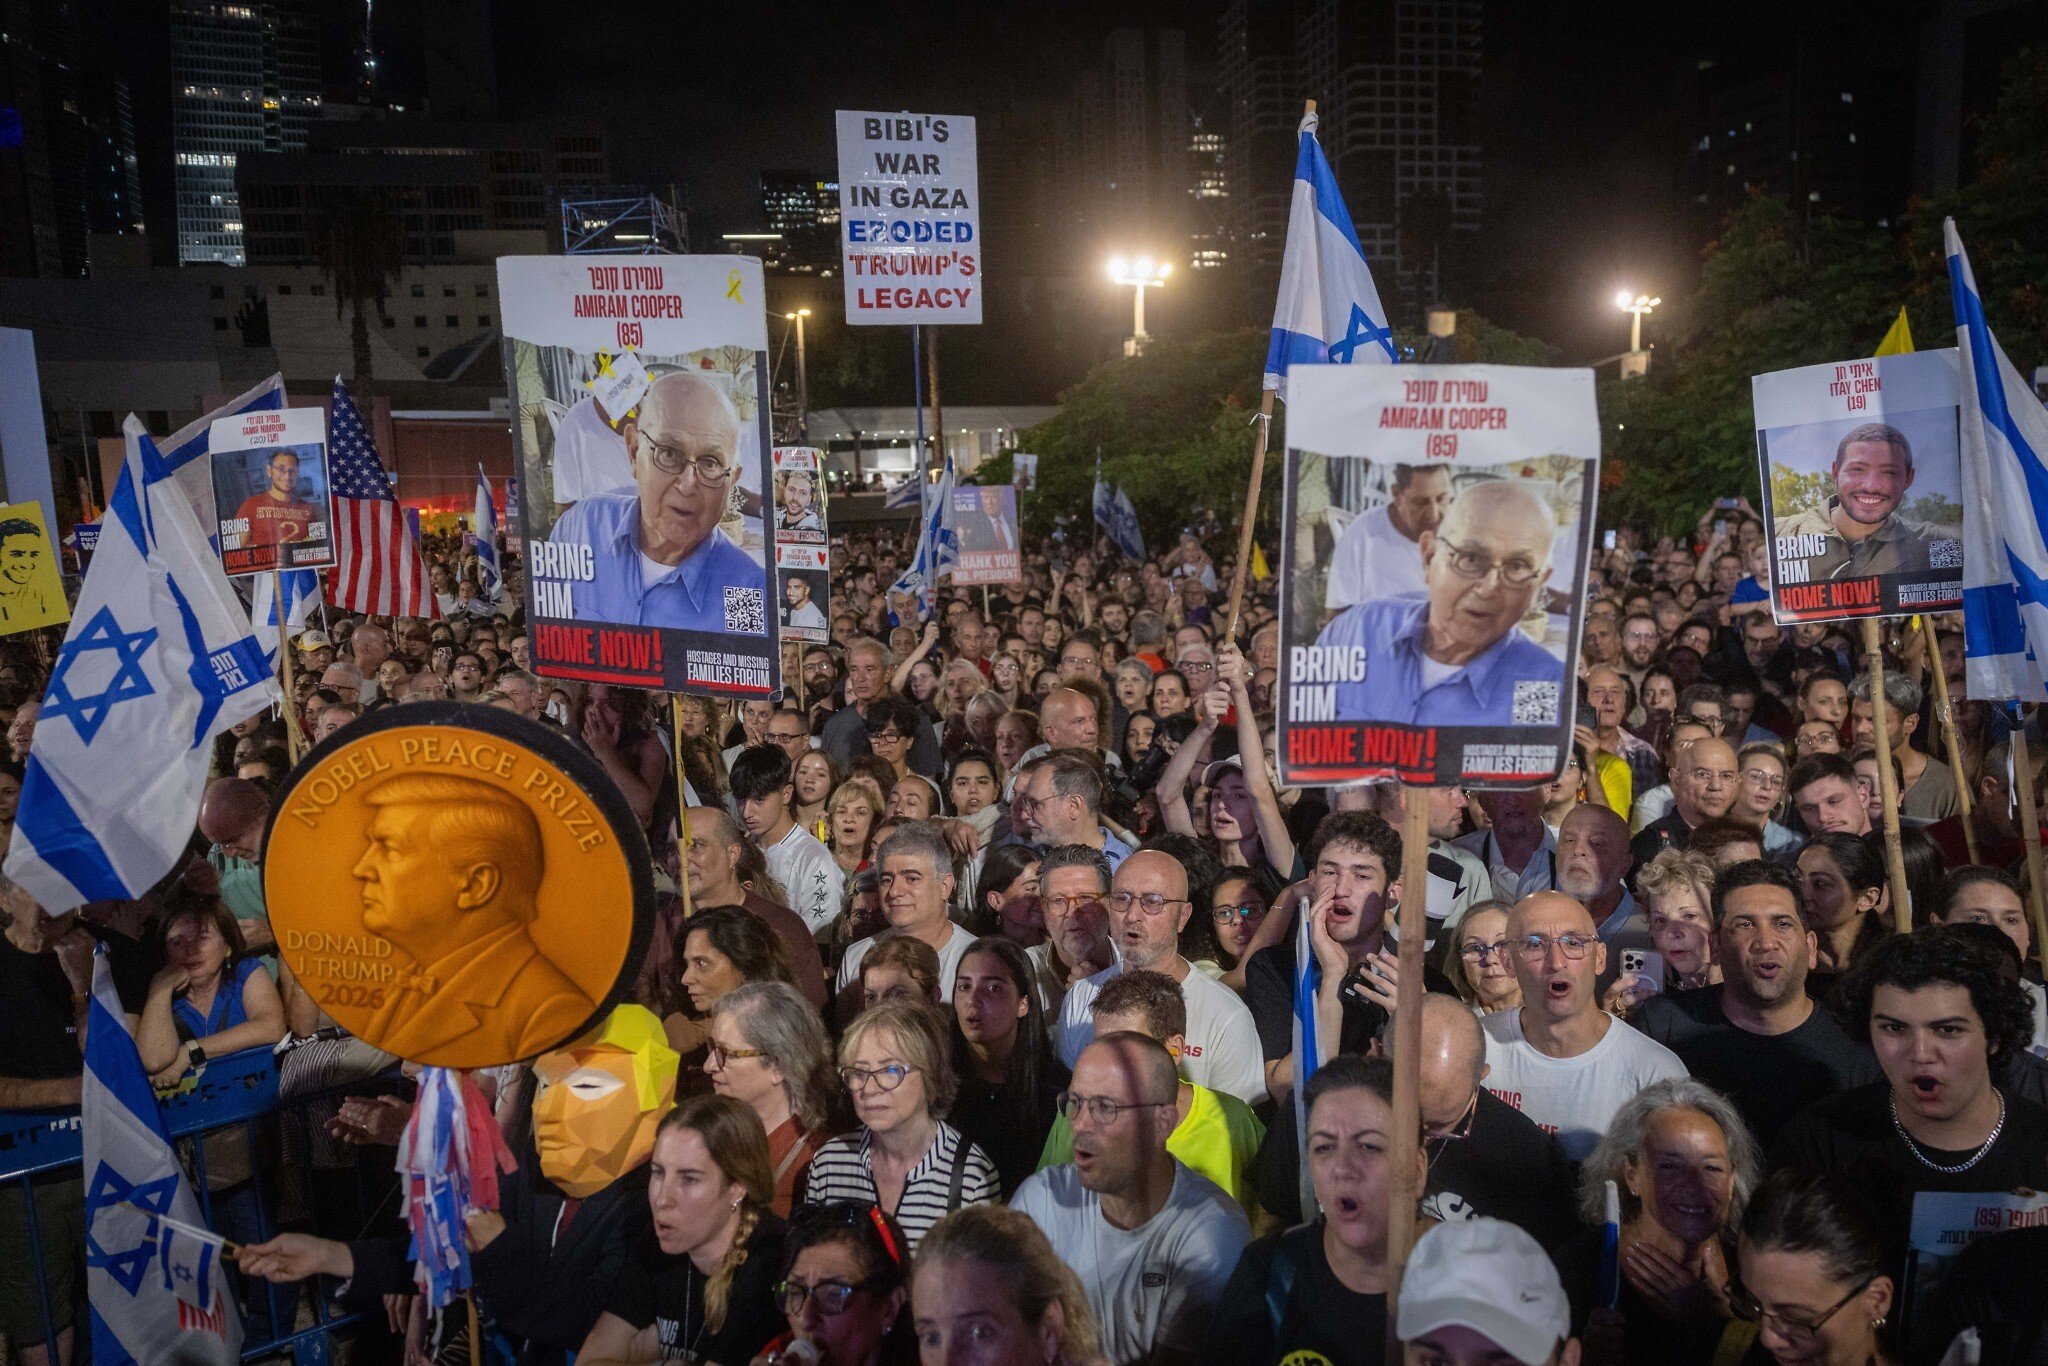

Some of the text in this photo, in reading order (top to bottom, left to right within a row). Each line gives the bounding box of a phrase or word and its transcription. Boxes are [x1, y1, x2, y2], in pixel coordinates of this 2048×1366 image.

[864, 116, 949, 143] BIBI'S
[875, 152, 941, 175] WAR
[850, 186, 880, 207] IN
[890, 187, 969, 209] GAZA
[849, 220, 973, 243] ERODED
[849, 251, 976, 276] TRUMP'S
[587, 266, 663, 292] עמירם קופר
[574, 294, 683, 319] AMIRAM COOPER
[857, 288, 971, 309] LEGACY
[617, 322, 643, 348] (85)
[1835, 362, 1873, 381] איתי חן
[1403, 380, 1488, 404] עמירם קופר
[1830, 377, 1881, 396] ITAY CHEN
[1847, 394, 1866, 411] (19)
[1379, 406, 1507, 429] AMIRAM COOPER
[1426, 433, 1458, 458] (85)
[220, 517, 249, 535] BRING
[222, 534, 241, 551] HIM
[1775, 533, 1826, 560] BRING
[225, 549, 250, 569] HOME
[530, 540, 594, 581] BRING
[960, 554, 1017, 569] HANK YOU
[973, 569, 1018, 581] PRESIDENT
[1778, 559, 1810, 585] HIM
[1779, 576, 1880, 611] HOME NOW!
[1898, 580, 1963, 593] HOSTAGES AND MISSIN
[1899, 590, 1936, 604] FAMILIES
[533, 581, 573, 619] HIM
[535, 624, 663, 672] HOME NOW!
[686, 649, 769, 670] HOSTAGES AND MISSING
[687, 662, 770, 688] FAMILIES FORUM
[1289, 645, 1367, 683] BRING
[1288, 684, 1336, 722] HIM
[1288, 727, 1436, 769] HOME NOW!
[1462, 756, 1557, 774] FAMILIES FORUM
[291, 736, 606, 852] NOBEL PEACE PRIZE
[286, 929, 391, 957] DONALD
[318, 982, 386, 1009] 2026
[1974, 1207, 2002, 1228] (85)
